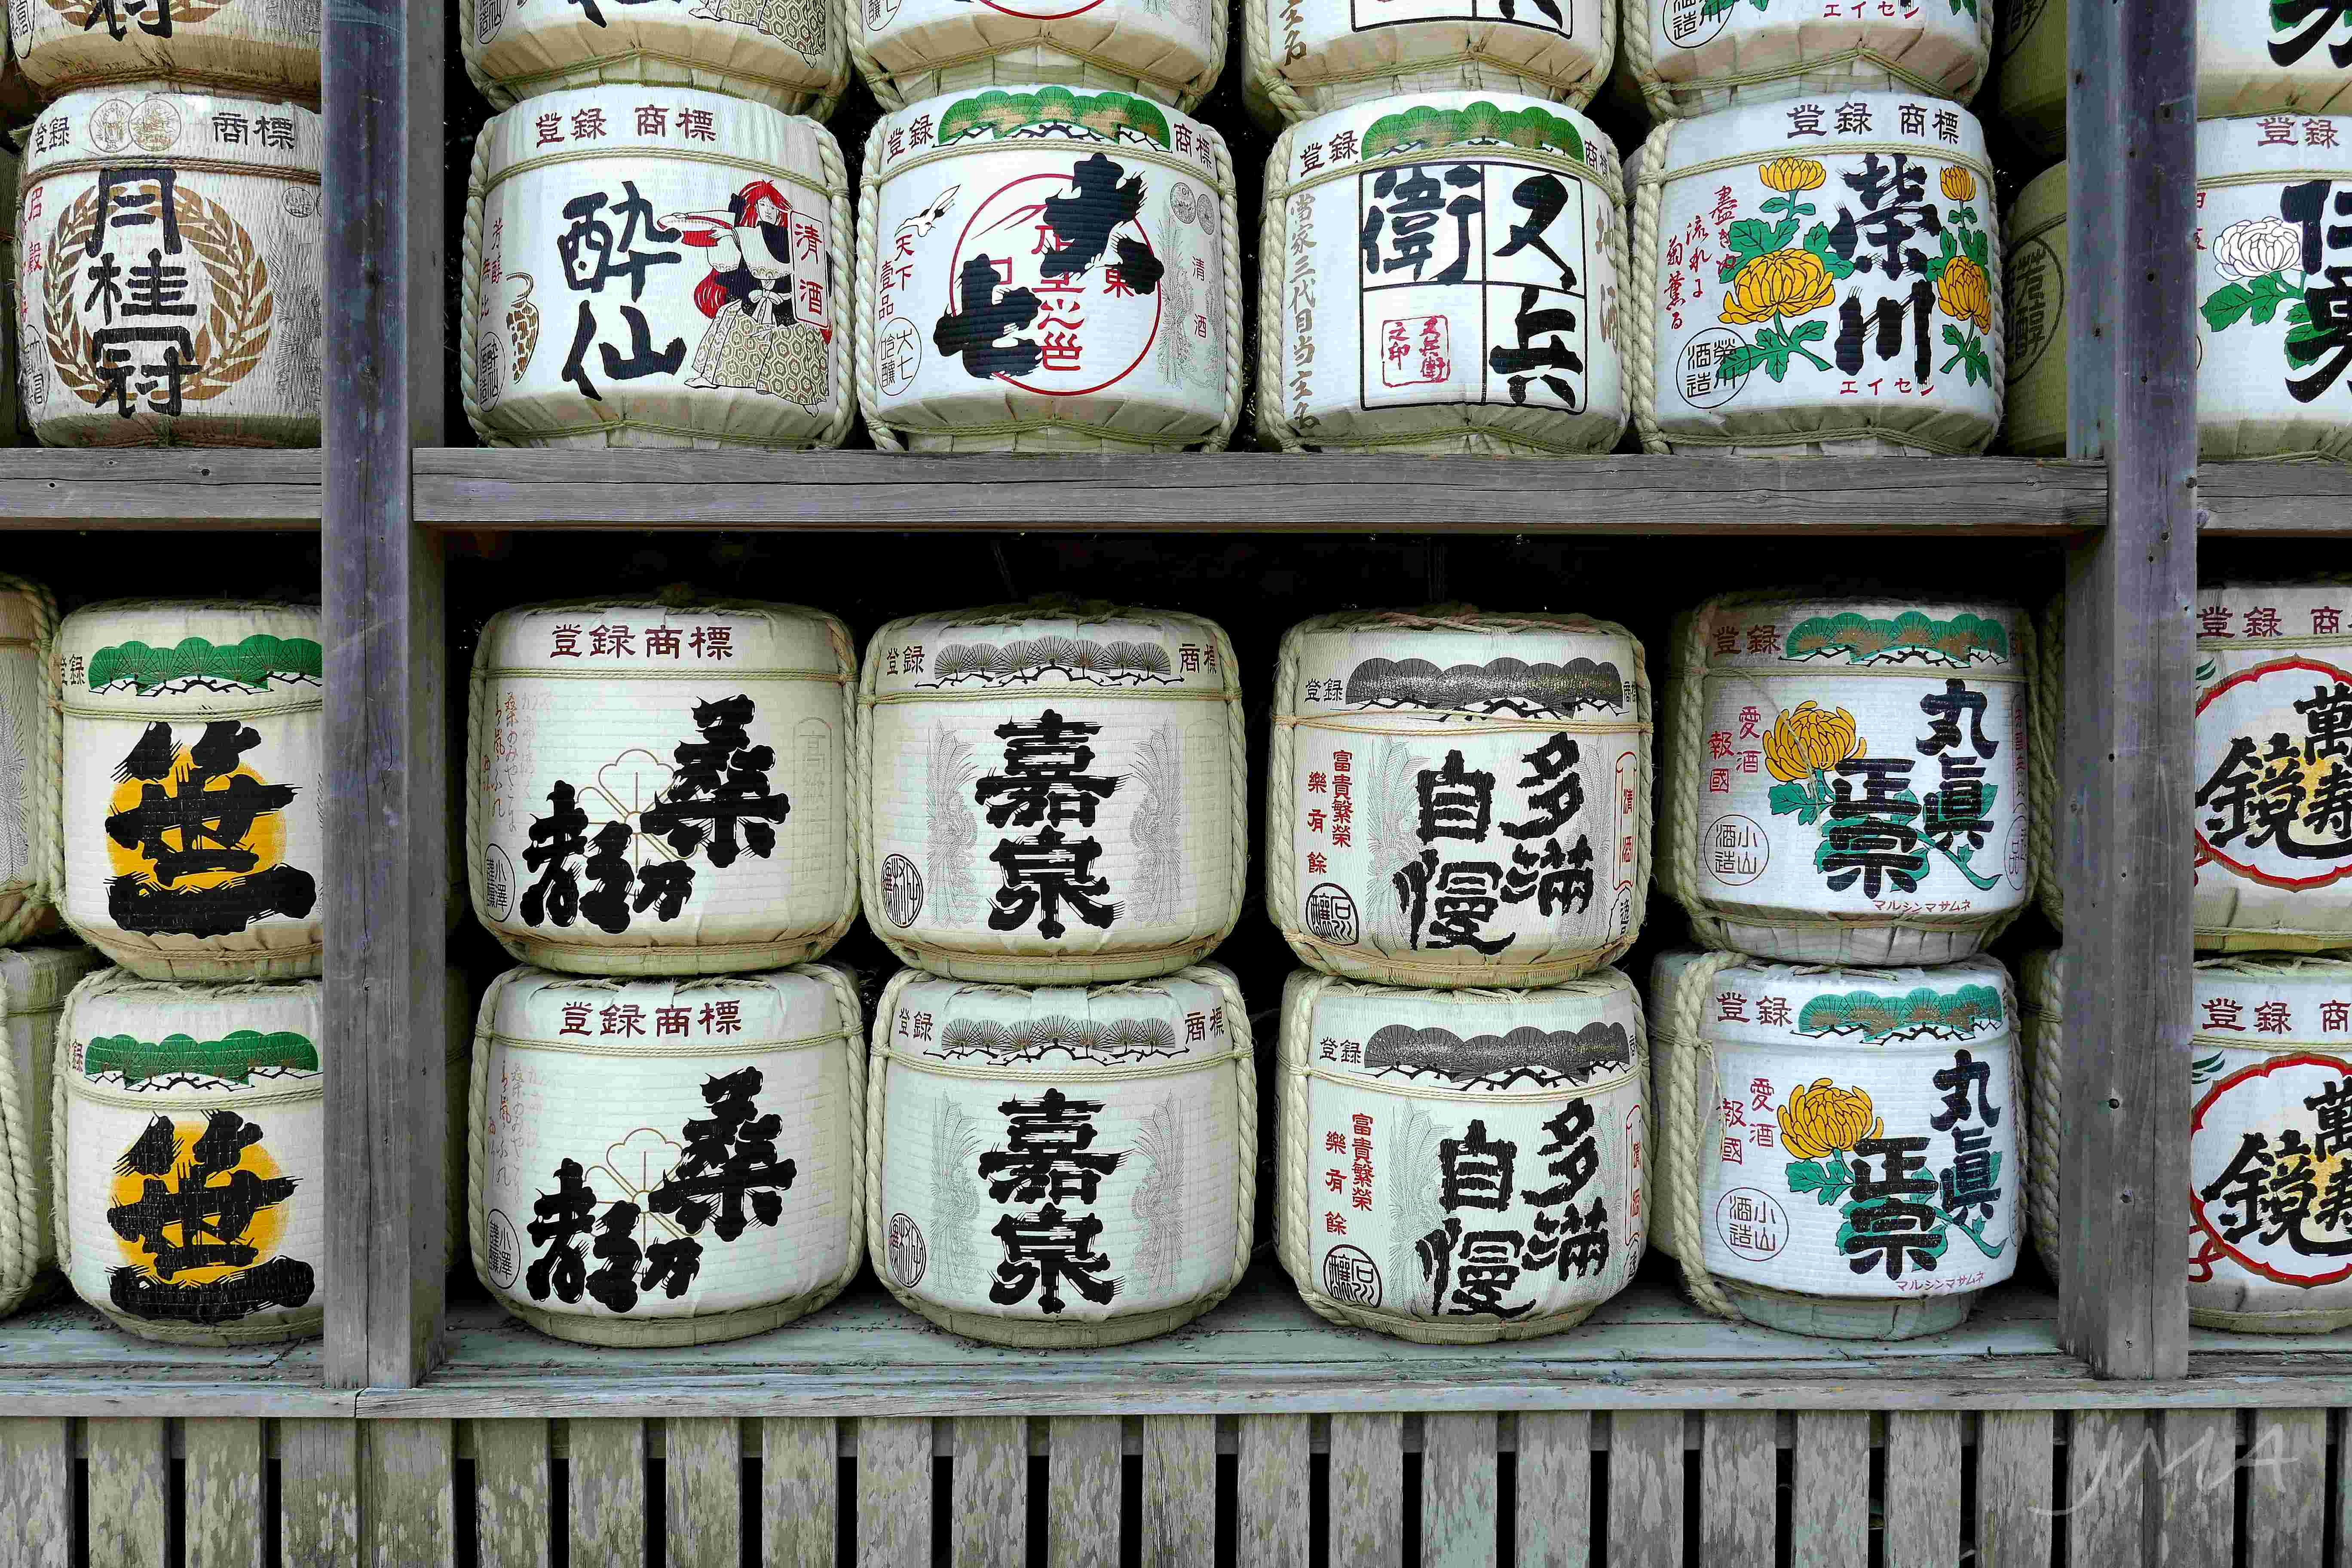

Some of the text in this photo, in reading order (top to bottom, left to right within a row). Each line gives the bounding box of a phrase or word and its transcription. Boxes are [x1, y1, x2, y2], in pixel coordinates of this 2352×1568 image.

[212, 113, 296, 150] 商標
[887, 114, 1213, 170] 登録 商標
[1300, 129, 1360, 178] 登録
[2256, 117, 2340, 148] 登録
[794, 223, 824, 317] 清酒
[894, 233, 915, 291] 天下
[84, 168, 202, 419] 月桂冠
[1191, 256, 1209, 340] 清酒
[1389, 323, 1411, 370] 之印
[1686, 341, 1712, 399] 酒造
[1839, 378, 1935, 396] エイセン
[549, 623, 733, 662] 登録商標
[1712, 624, 1781, 657] 登録
[2196, 606, 2352, 639] 登録 商
[886, 645, 925, 677] 登録
[1304, 677, 1344, 703] 登録
[1707, 730, 1734, 794] 報國
[1736, 705, 1762, 775] 愛酒
[975, 709, 1134, 940] 嘉泉
[1714, 823, 1736, 875] 酒造
[1822, 758, 1924, 900] 正宗
[1393, 749, 1517, 956] 自慢
[1737, 826, 1758, 875] 小山
[1873, 899, 1972, 914] マルシンマサムネ
[559, 1000, 742, 1038] 登録商標
[898, 1007, 1225, 1044] 登録 商標
[1716, 992, 1793, 1028] 登録
[2202, 998, 2293, 1034] 登録
[1320, 1036, 1362, 1065] 登録
[1749, 1078, 1775, 1148] 愛酒
[977, 1087, 1136, 1315] 嘉泉
[1415, 1118, 1537, 1318] 自慢
[1729, 1194, 1752, 1250] 酒造
[1754, 1200, 1777, 1252] 小山
[1845, 1136, 1943, 1281] 正宗
[1896, 1271, 1985, 1292] マルシンマサムネ
